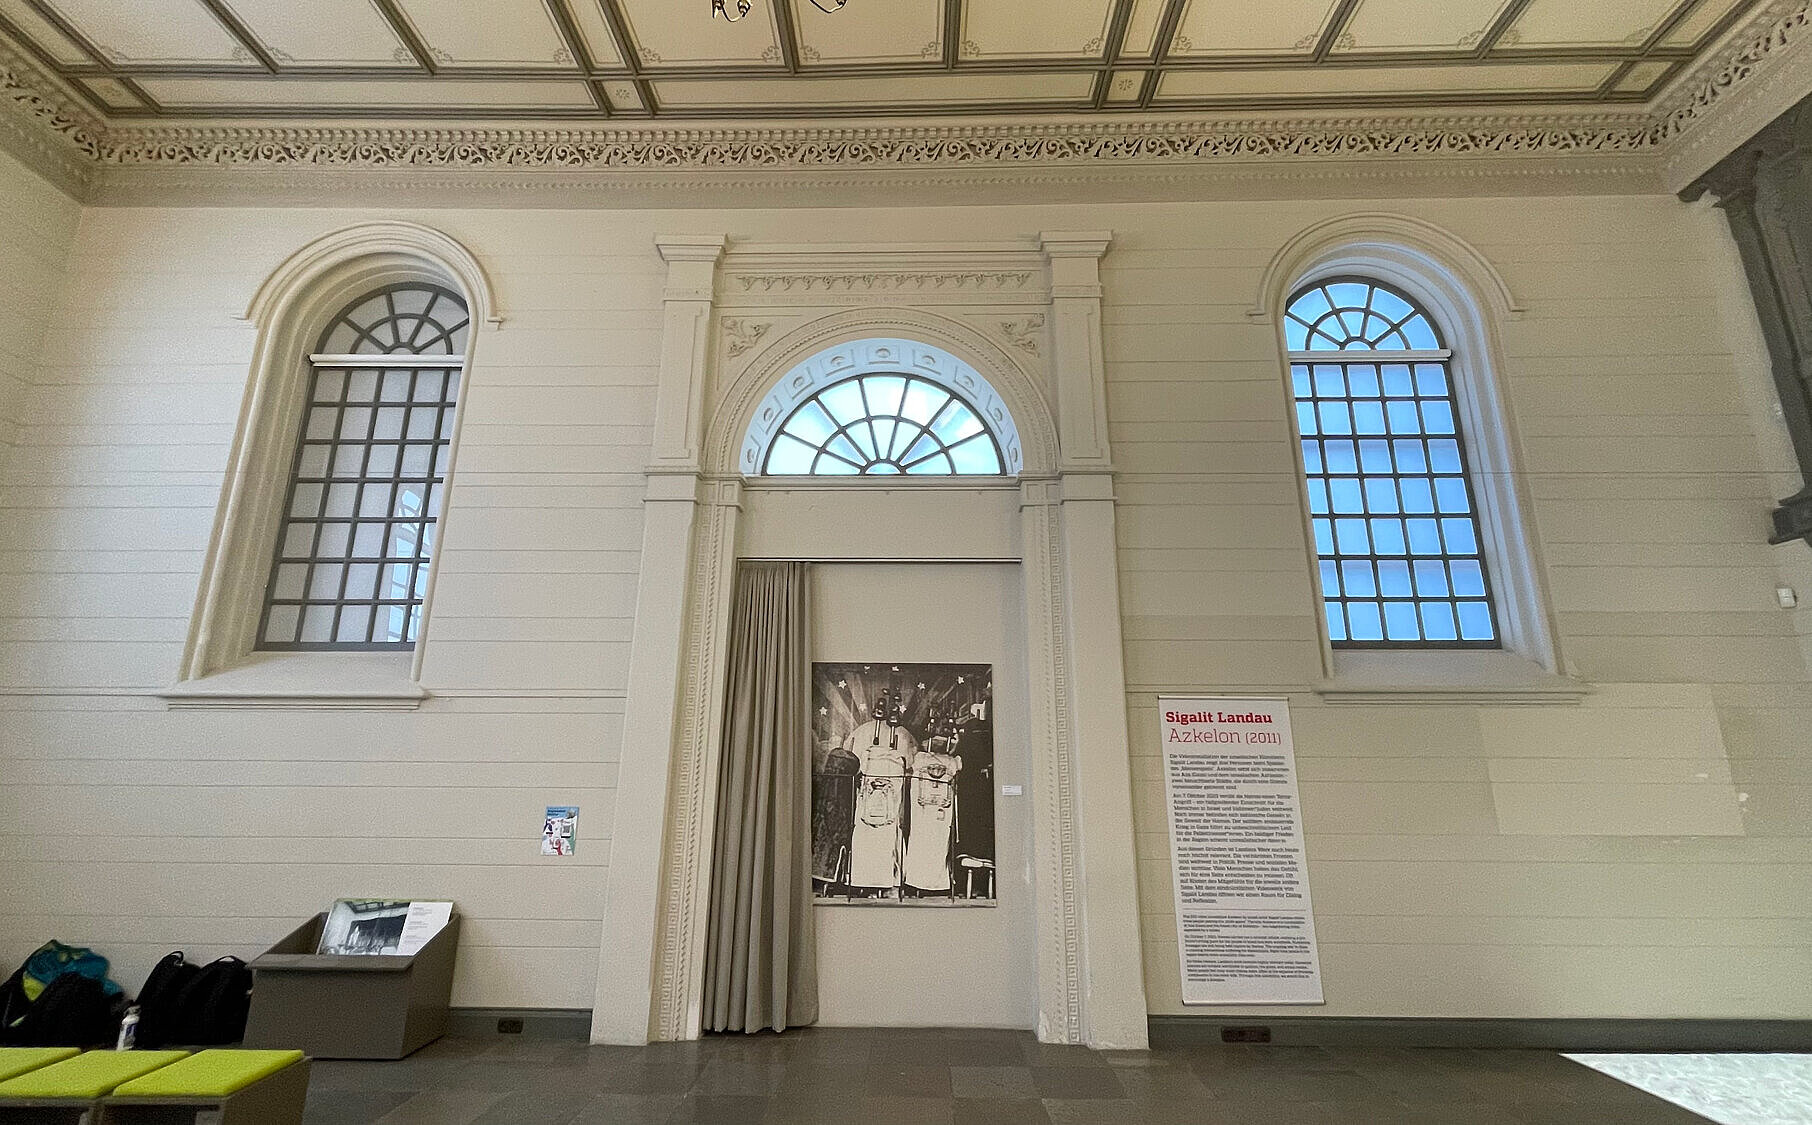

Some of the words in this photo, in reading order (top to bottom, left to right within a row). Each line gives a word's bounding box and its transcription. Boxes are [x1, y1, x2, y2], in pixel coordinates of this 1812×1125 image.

[1166, 711, 1214, 725] Sigalit
[1217, 712, 1272, 723] Landau
[1168, 728, 1240, 743] Azkelon
[1246, 732, 1282, 745] (2011)
